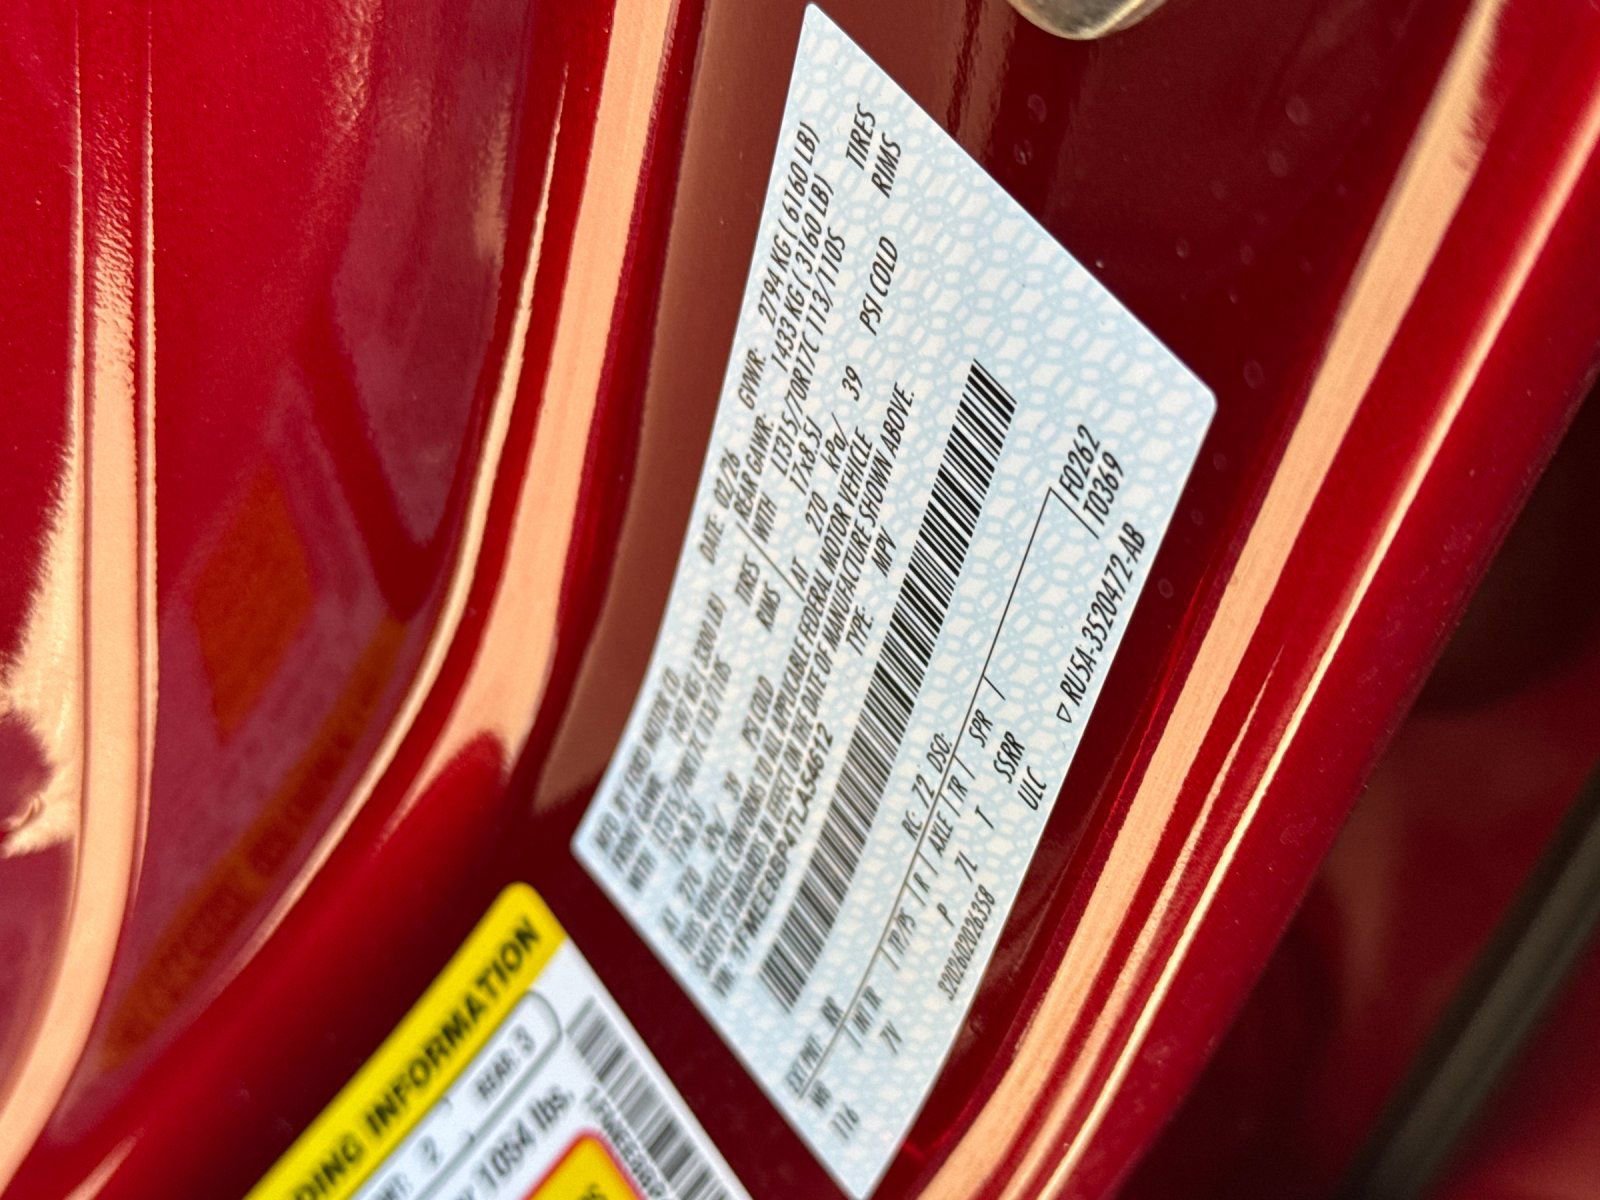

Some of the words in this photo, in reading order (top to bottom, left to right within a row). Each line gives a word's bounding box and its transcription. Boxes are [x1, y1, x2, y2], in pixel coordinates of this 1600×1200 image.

[793, 119, 819, 167] LB)
[781, 160, 809, 224] 6160
[808, 171, 834, 218] LB)
[770, 232, 792, 273] KG
[777, 217, 797, 241] (
[795, 211, 823, 275] 3160
[791, 268, 810, 291] (
[868, 234, 898, 298] COLD
[751, 490, 777, 544] WITH
[769, 329, 820, 477] LT315/70R17C
[804, 224, 847, 337] 113/110S
[844, 101, 876, 171] TIRES
[757, 266, 784, 327] 2794
[783, 282, 805, 322] KG
[789, 414, 823, 496] 17x8.5J
[871, 131, 901, 199] RIMS
[858, 291, 883, 336] PSI
[770, 314, 797, 373] 1433
[737, 344, 765, 411] GVWR:
[840, 363, 863, 402] 39
[745, 410, 774, 477] GAWR:
[820, 411, 850, 475] kPa/
[879, 379, 914, 458] ABOVE.
[837, 425, 872, 508] VEHICLE
[857, 448, 893, 528] SHOWN
[1058, 423, 1100, 501] F0262
[1083, 449, 1124, 526] T0369
[699, 510, 724, 566] DATE:
[712, 445, 741, 511] 02/26
[733, 470, 758, 523] REAR
[804, 489, 828, 536] 270
[818, 501, 851, 575] MOTOR
[734, 553, 760, 607] TIRES
[789, 554, 809, 590] AT
[821, 519, 872, 652] MANUFACTURE
[845, 602, 874, 656] TYPE:
[870, 524, 897, 578] MPV
[755, 580, 781, 632] RIMS
[797, 566, 832, 645] FEDERAL
[1059, 520, 1145, 705] RU5A-3520472-AB
[682, 671, 701, 704] KG
[693, 619, 717, 670] 3300
[705, 591, 726, 629] LB)
[812, 640, 834, 676] OF
[749, 673, 774, 723] COLD
[771, 635, 811, 733] APPLICABLE
[800, 666, 826, 717] DATE
[641, 690, 671, 750] MOTOR
[741, 714, 761, 750] PSI
[761, 726, 782, 764] ALL
[790, 707, 813, 748] THE
[752, 753, 773, 784] TO
[782, 739, 803, 773] ON
[925, 729, 952, 774] DSO:
[722, 769, 742, 803] 39
[765, 764, 794, 823] EFFECT
[911, 772, 934, 808] 72
[1017, 764, 1047, 811] ULC
[729, 722, 834, 960] 1FMEE8BP4TLA54612
[757, 814, 776, 842] IN
[901, 807, 923, 841] RC:
[676, 863, 702, 905] 270
[861, 984, 882, 1011] TR
[886, 905, 917, 956] TP/PS
[913, 871, 930, 893] R
[927, 810, 954, 858] AXLE
[947, 773, 968, 803] TR
[968, 707, 993, 749] SPR
[879, 1019, 902, 1053] 7V
[936, 901, 955, 927] P
[954, 848, 977, 882] 7L
[974, 804, 994, 830] T
[992, 729, 1024, 784] SSRR
[937, 883, 995, 1001] 3202602026358
[366, 916, 540, 1136] INFORMATION
[515, 1026, 535, 1052] 3
[479, 1120, 536, 1188] 1054
